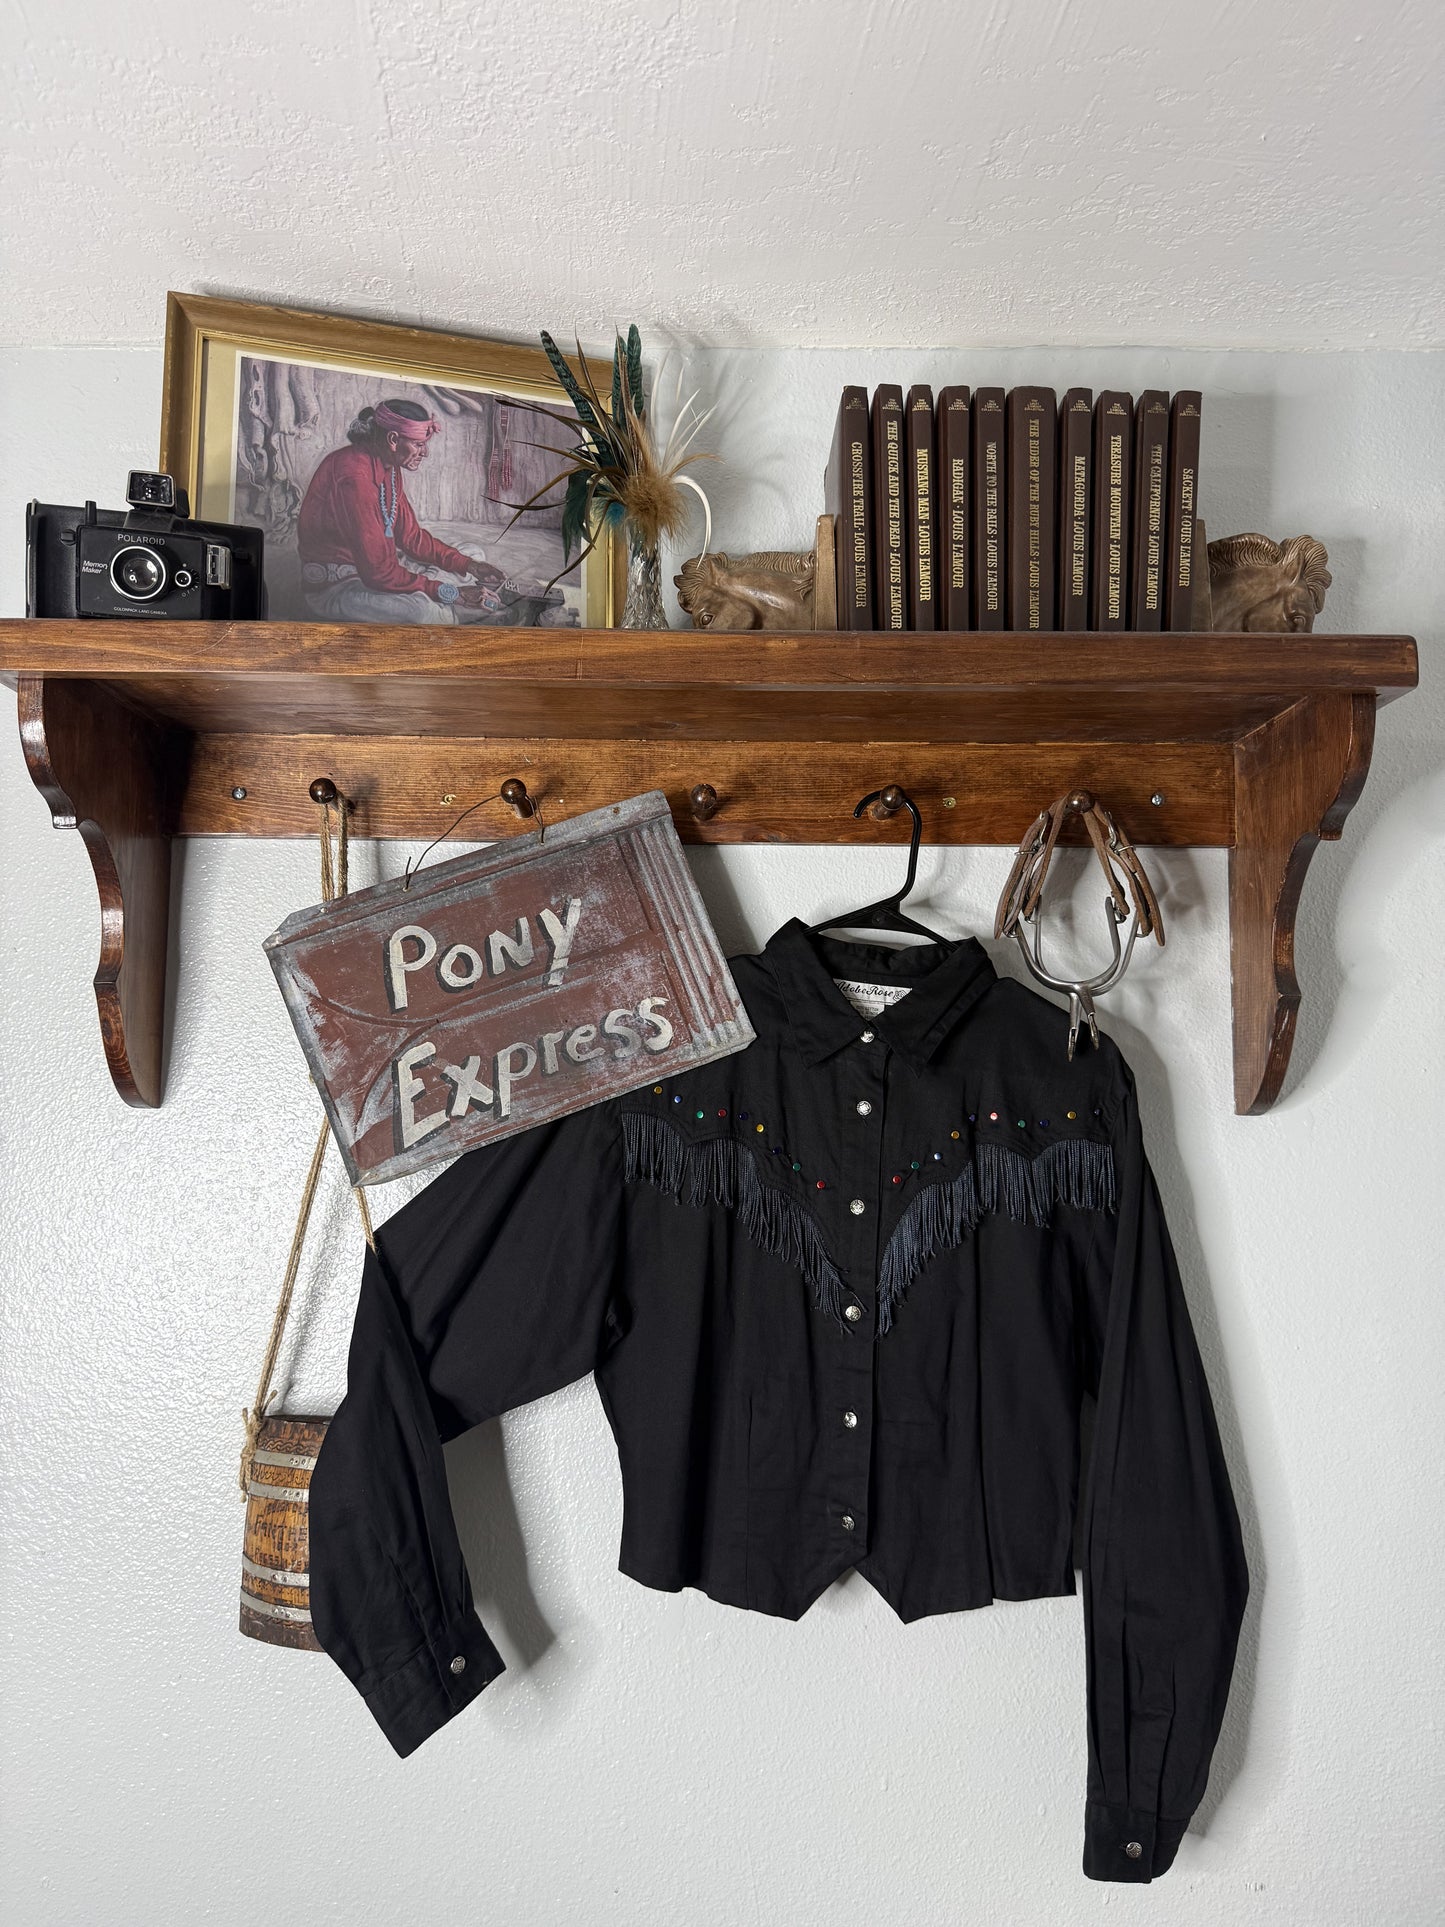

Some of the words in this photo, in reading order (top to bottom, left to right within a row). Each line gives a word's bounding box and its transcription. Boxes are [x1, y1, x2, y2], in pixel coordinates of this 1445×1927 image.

[888, 421, 897, 440] THE
[1030, 419, 1040, 437] THE
[888, 442, 899, 474] QUICK
[1030, 439, 1040, 468] RIDER
[1111, 435, 1122, 485] TREASURE
[888, 476, 899, 496] AND
[917, 449, 929, 495] MUSTANG
[953, 459, 963, 504] RADIGAN
[1030, 470, 1040, 481] OF
[1074, 456, 1086, 517] MATAGORDA
[987, 488, 997, 507] THE
[1030, 484, 1040, 502] THE
[1182, 468, 1193, 510] SACKETT
[853, 499, 865, 528] TRAIL
[889, 499, 899, 519] THE
[918, 498, 930, 520] MAN
[987, 509, 997, 534] RAILS
[1030, 505, 1040, 528] RUBY
[1110, 487, 1122, 540] MOUNTAIN
[117, 533, 166, 546] POLAROID
[889, 521, 900, 547] DEAD
[919, 525, 930, 555] LOUIS
[953, 510, 963, 541] LOUIS
[1073, 522, 1085, 551] LOUIS
[1181, 514, 1192, 543] LOUIS
[854, 533, 866, 562] LOUIS
[987, 540, 997, 568] LOUIS
[1030, 530, 1040, 556] HILLS
[1147, 536, 1160, 565] LOUIS
[81, 566, 103, 574] Maker
[83, 560, 108, 570] Memory
[890, 553, 900, 583] LOUIS
[953, 544, 963, 588] L'AMOUR
[1109, 544, 1121, 574] LOUIS
[1179, 546, 1190, 587] L'AMOUR
[855, 565, 866, 608] L'AMOUR
[920, 558, 931, 601] L'AMOUR
[1030, 561, 1040, 588] LOUIS
[1072, 553, 1084, 596] L'AMOUR
[1146, 568, 1158, 610] L'AMOUR
[987, 570, 998, 610] L'AMOUR
[1109, 577, 1120, 619] L'AMOUR
[891, 586, 902, 629] L'AMOUR
[1030, 590, 1040, 629] L'AMOUR
[394, 996, 674, 1150] Express
